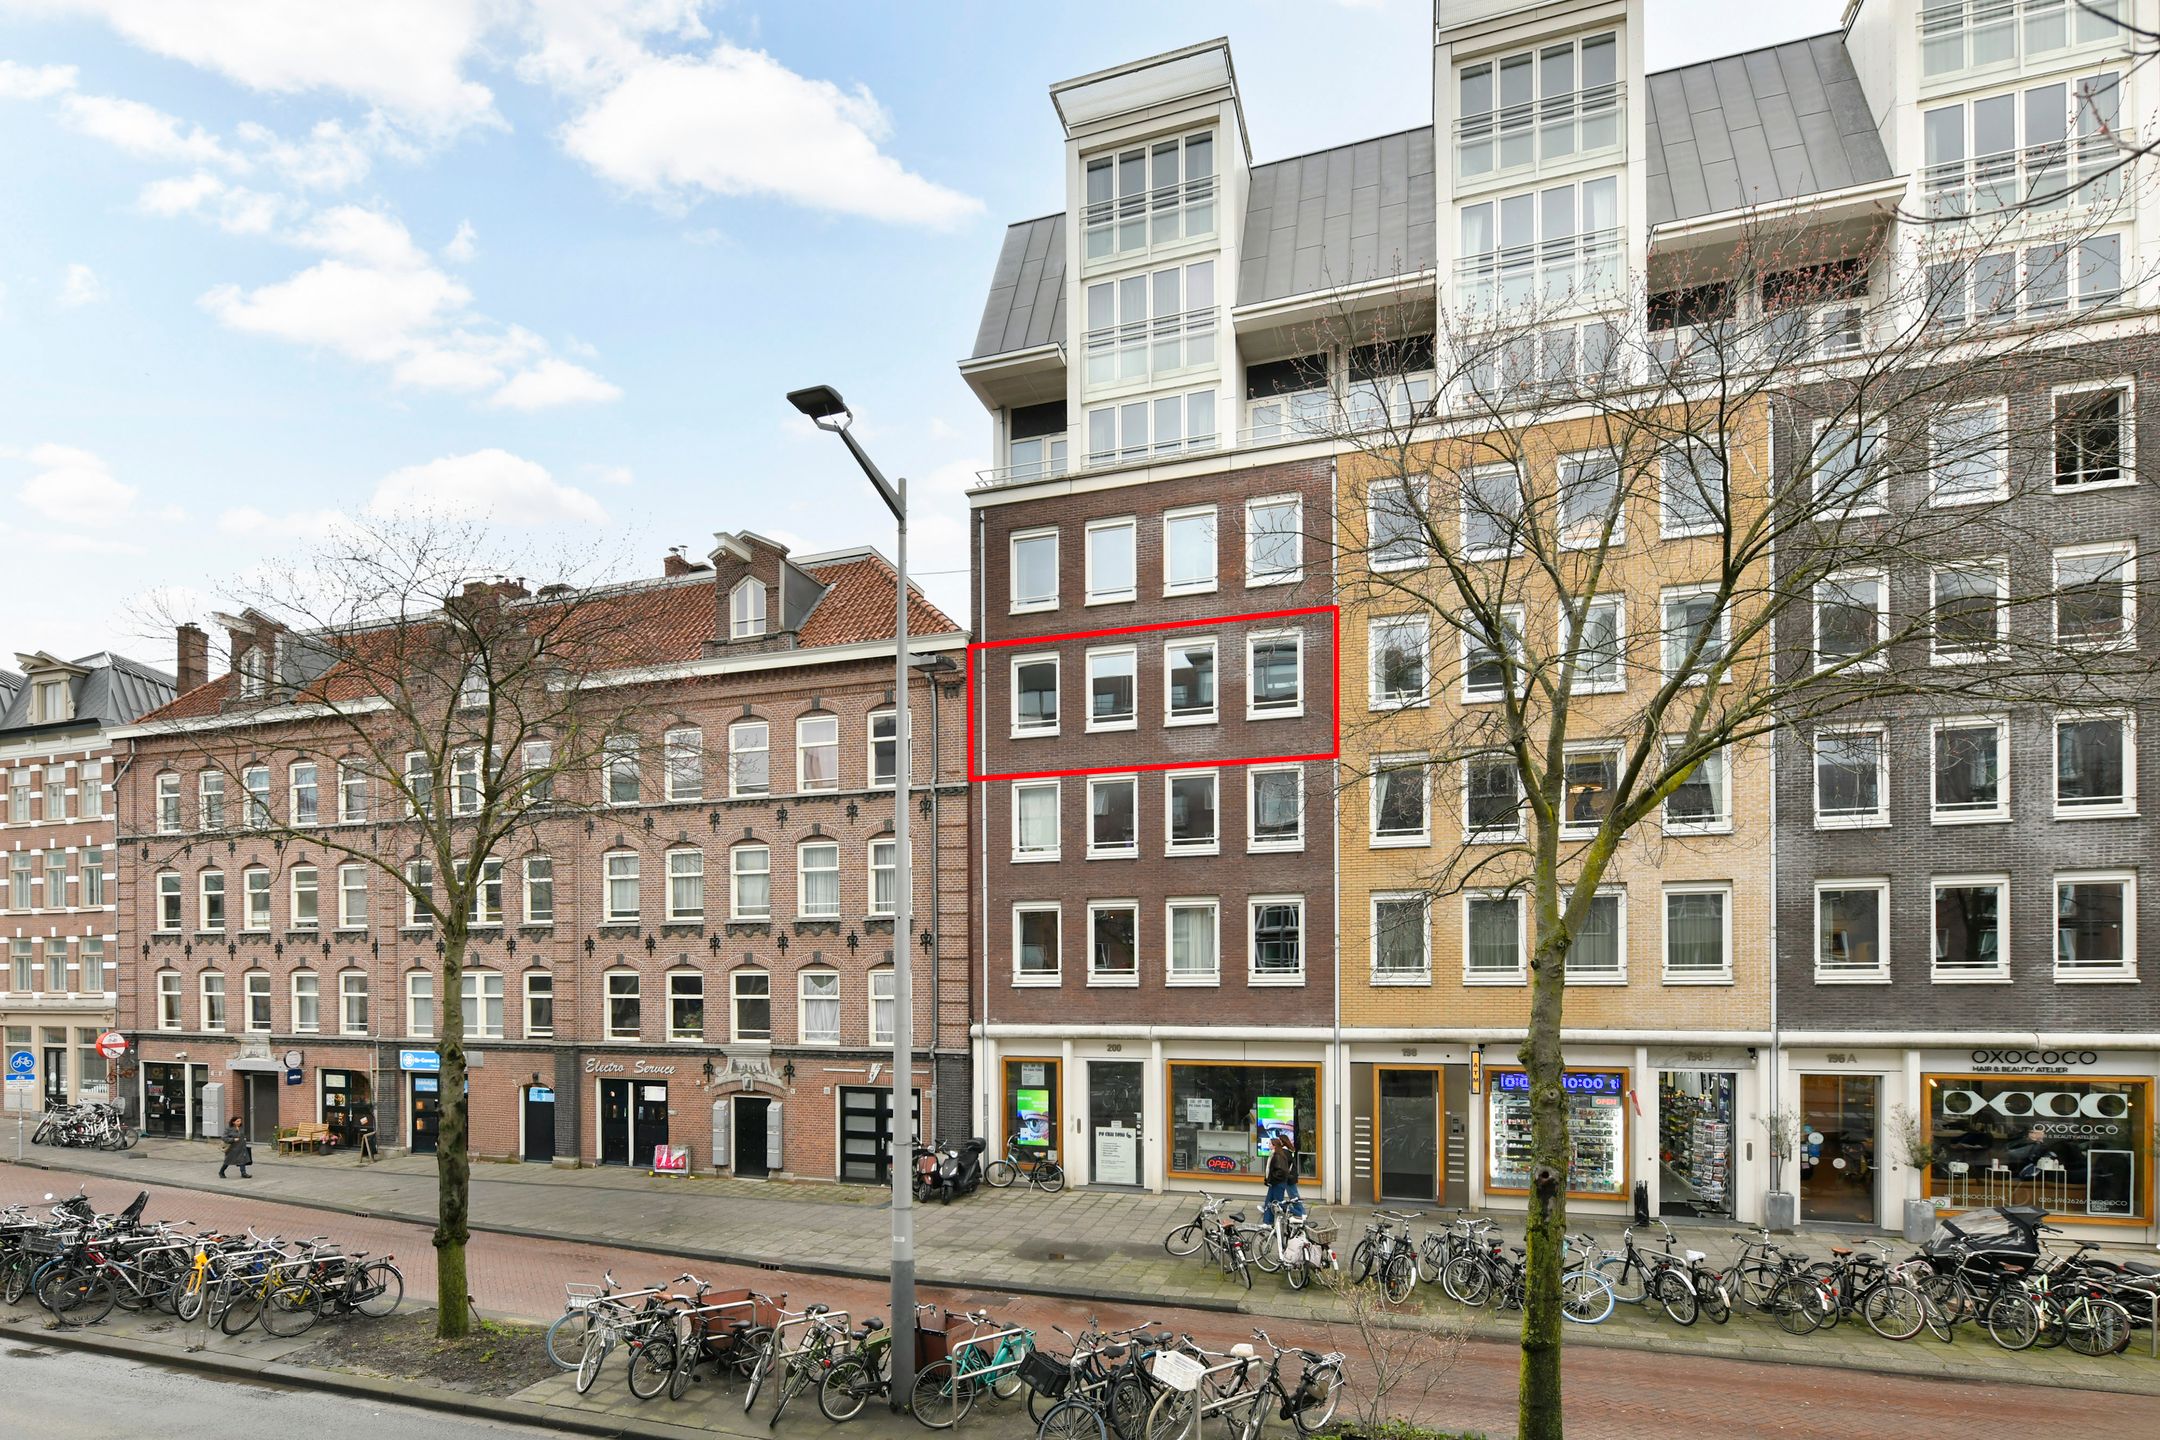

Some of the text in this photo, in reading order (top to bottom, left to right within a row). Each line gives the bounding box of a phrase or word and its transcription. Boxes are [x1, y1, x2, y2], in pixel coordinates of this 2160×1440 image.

[1107, 1044, 1122, 1053] 200
[1401, 1048, 1418, 1057] 198
[1971, 1050, 2098, 1065] OXOCOCO
[585, 1058, 677, 1075] Electro Service
[2032, 1123, 2119, 1136] OXOCOCO
[1208, 1159, 1235, 1170] OPEN
